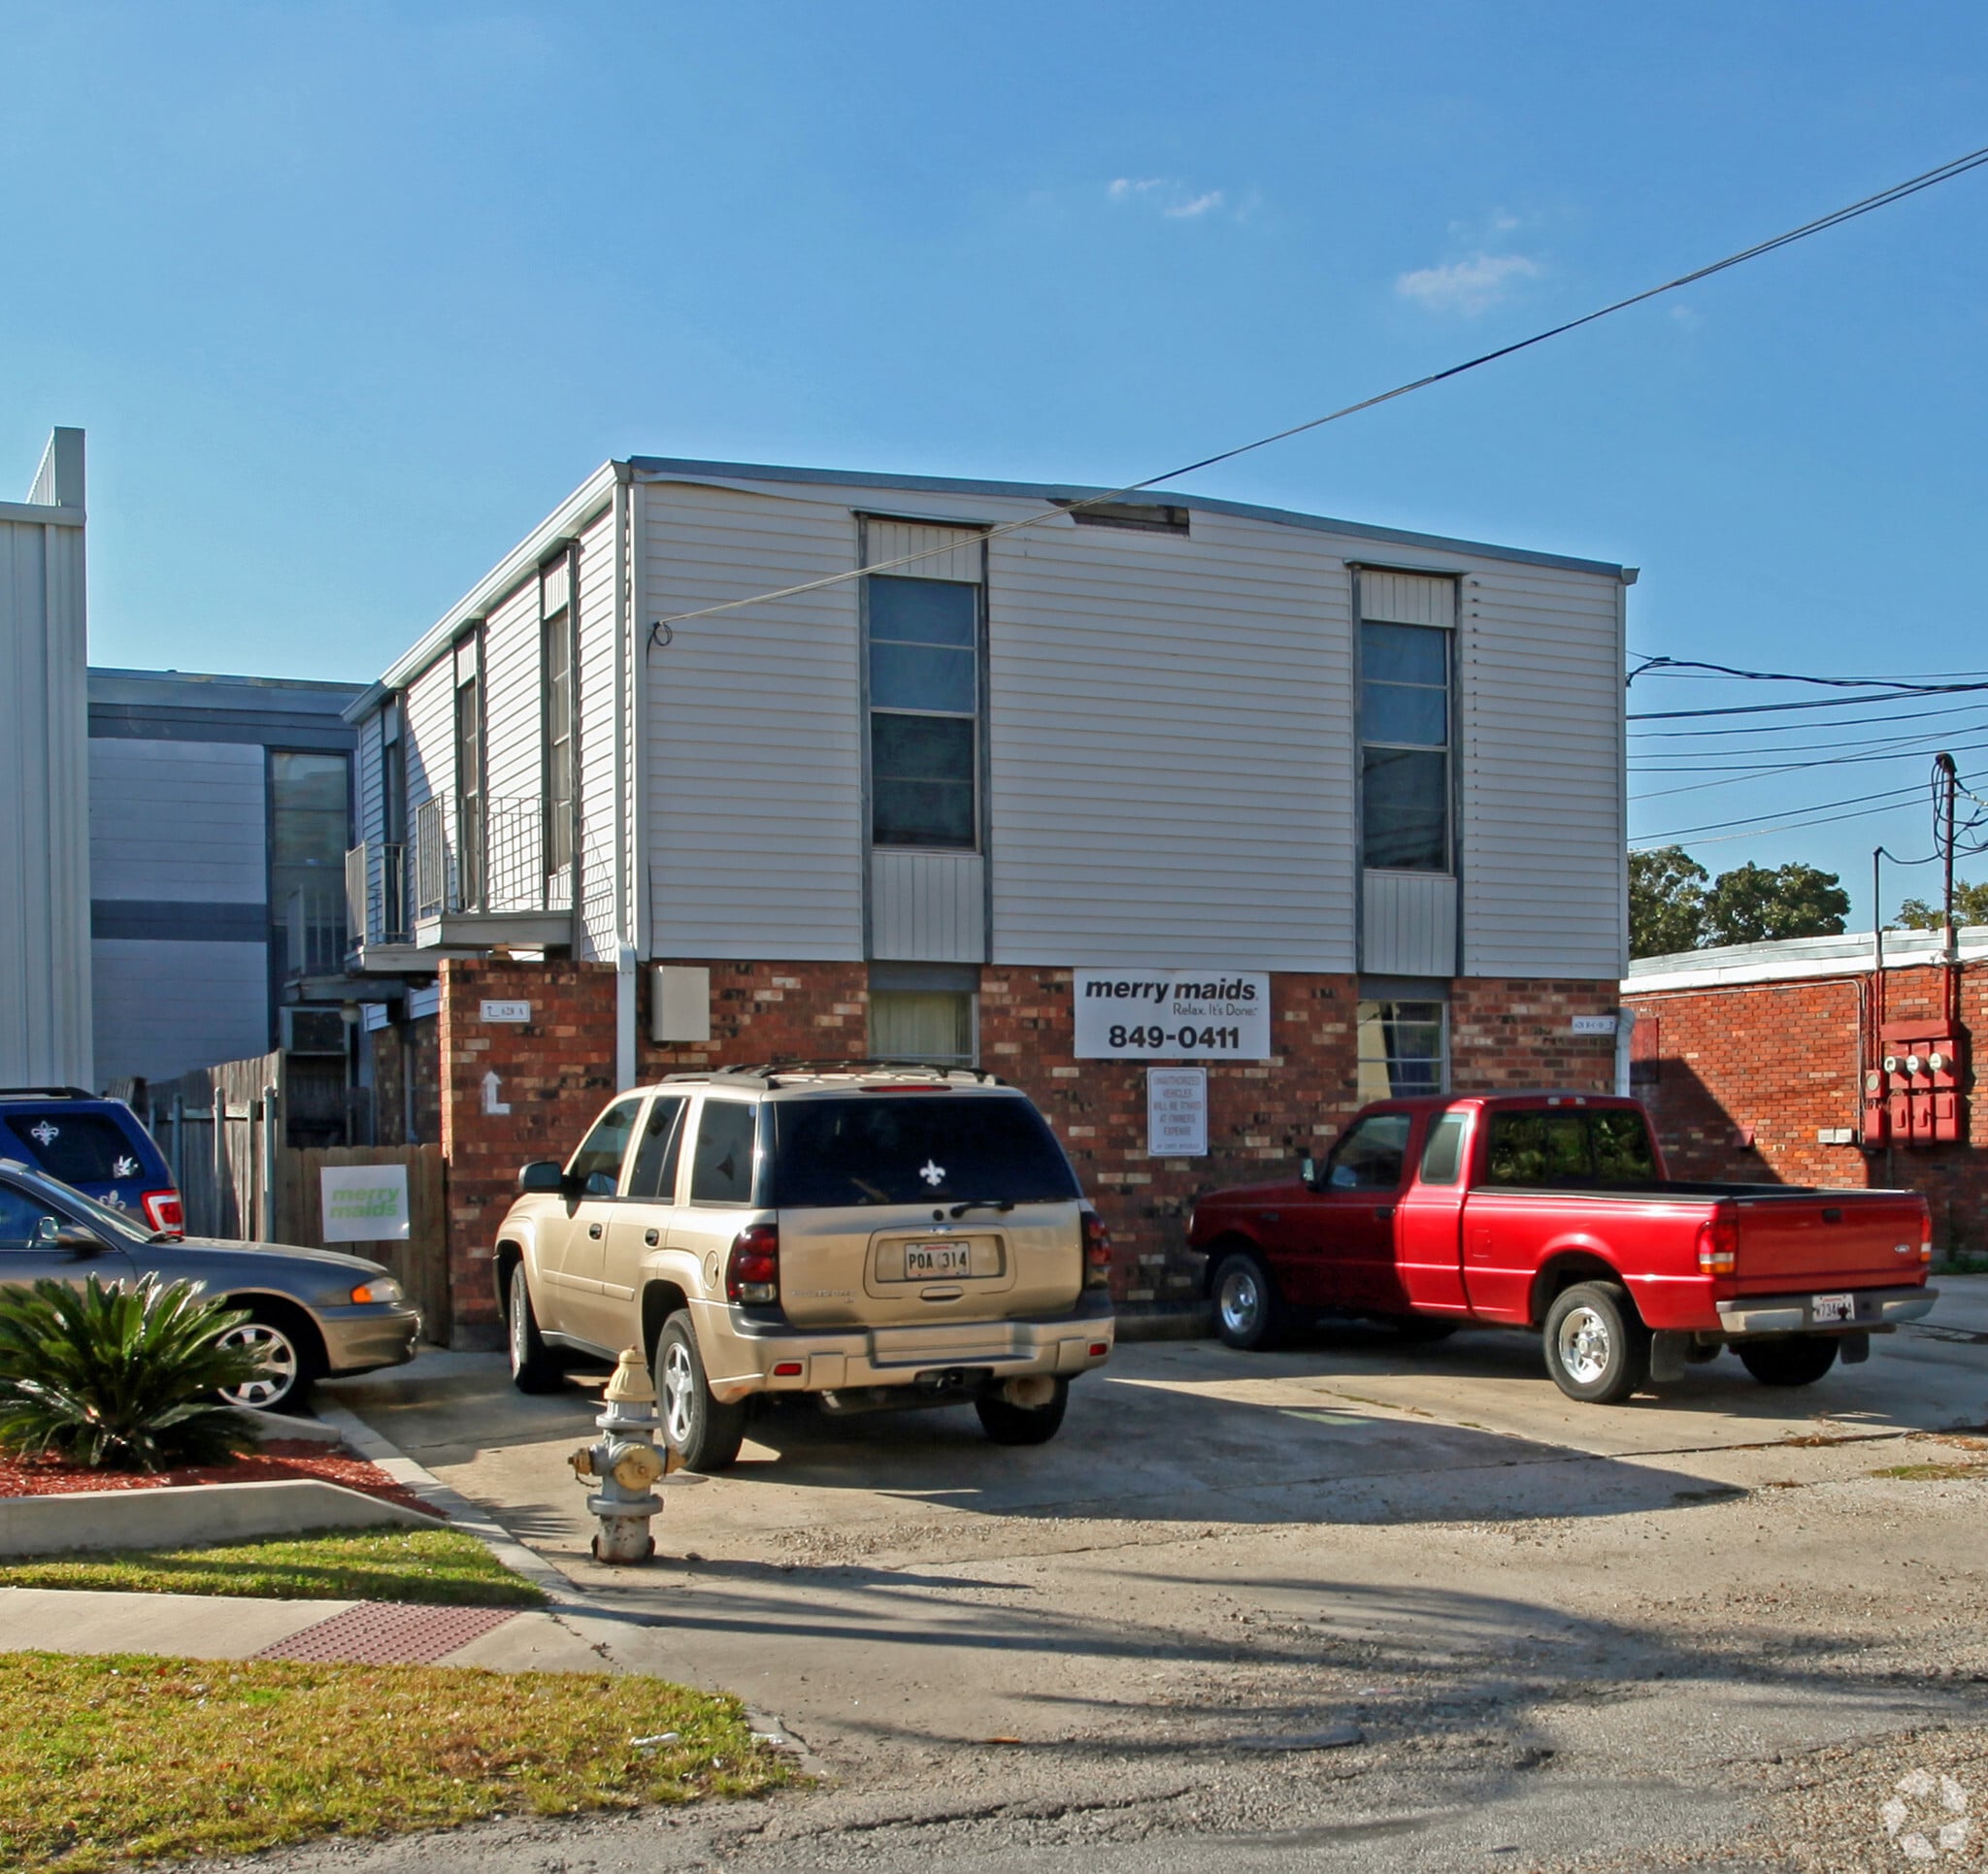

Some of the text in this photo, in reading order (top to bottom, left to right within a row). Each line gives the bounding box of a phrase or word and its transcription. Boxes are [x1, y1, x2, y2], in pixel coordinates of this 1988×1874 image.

[1085, 978, 1256, 1003] merry maids
[1174, 1003, 1207, 1016] Relax.
[1209, 1003, 1223, 1016] It's
[1109, 1025, 1240, 1049] 849-0411
[1154, 1076, 1201, 1086] UNAUTHORIZED
[1163, 1089, 1192, 1099] VEHICLES
[1153, 1101, 1168, 1111] WILL
[1170, 1101, 1178, 1111] BE
[1159, 1114, 1167, 1123] AT
[1164, 1126, 1191, 1135] EXPENSE
[331, 1187, 400, 1202] merry
[330, 1201, 397, 1219] maids
[909, 1251, 967, 1269] POA 314
